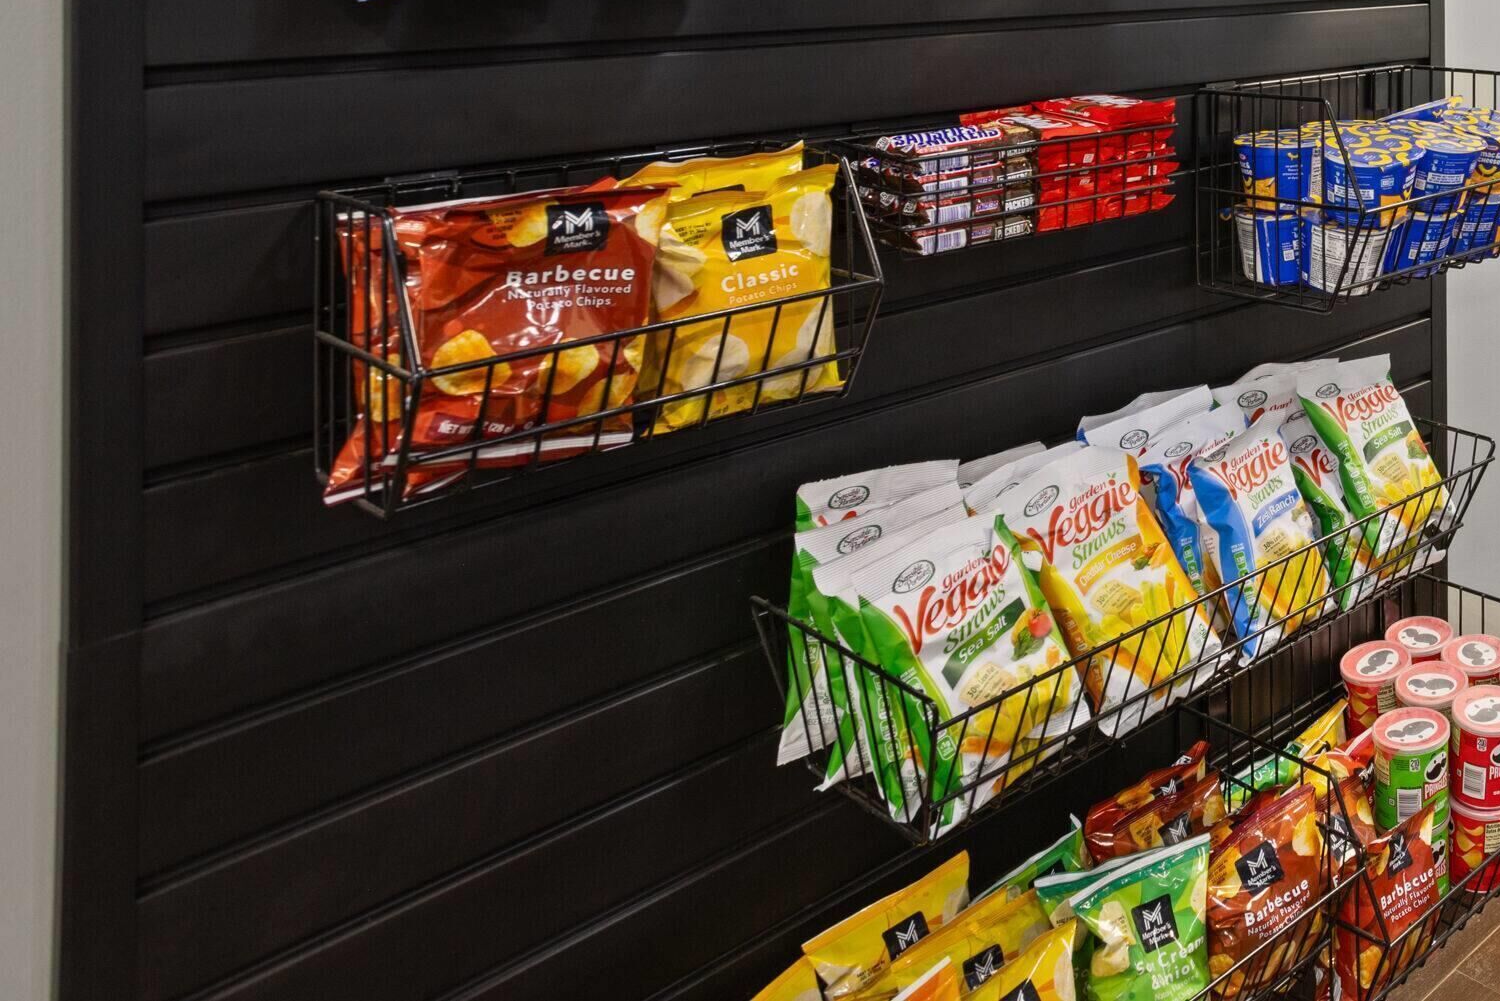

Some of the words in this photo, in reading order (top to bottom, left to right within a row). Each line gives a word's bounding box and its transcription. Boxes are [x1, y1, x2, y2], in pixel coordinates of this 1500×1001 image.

[554, 231, 601, 245] Member's
[506, 264, 636, 287] Barbecue
[575, 284, 632, 294] Flavored
[721, 263, 799, 293] Classic
[576, 295, 612, 308] Chips
[729, 291, 766, 305] Potato
[768, 282, 798, 295] Chips
[1321, 383, 1400, 433] Veggie
[1362, 406, 1399, 440] Straws
[1231, 441, 1261, 470] garden
[1373, 434, 1388, 449] Sea
[1209, 440, 1289, 501] Veggie
[1069, 481, 1107, 514] garden
[1270, 494, 1296, 516] Ranch
[1027, 478, 1137, 565] Veggie
[1072, 518, 1126, 570] Straws
[1105, 542, 1137, 565] Cheese
[942, 556, 986, 594] garden
[893, 544, 1010, 655] Veggie
[943, 582, 1007, 655] Straws
[959, 639, 984, 664] Sea
[987, 614, 1008, 638] Salt
[1423, 776, 1448, 800] PRINGLES
[1244, 879, 1309, 927] Barbecue
[1380, 867, 1434, 911] Barbecue
[1383, 898, 1409, 920] Naturally
[1409, 879, 1436, 901] Flavored
[1247, 913, 1279, 937] Naturally
[1280, 890, 1311, 918] Flavored
[1390, 905, 1413, 923] Potato
[1413, 893, 1431, 909] Chips
